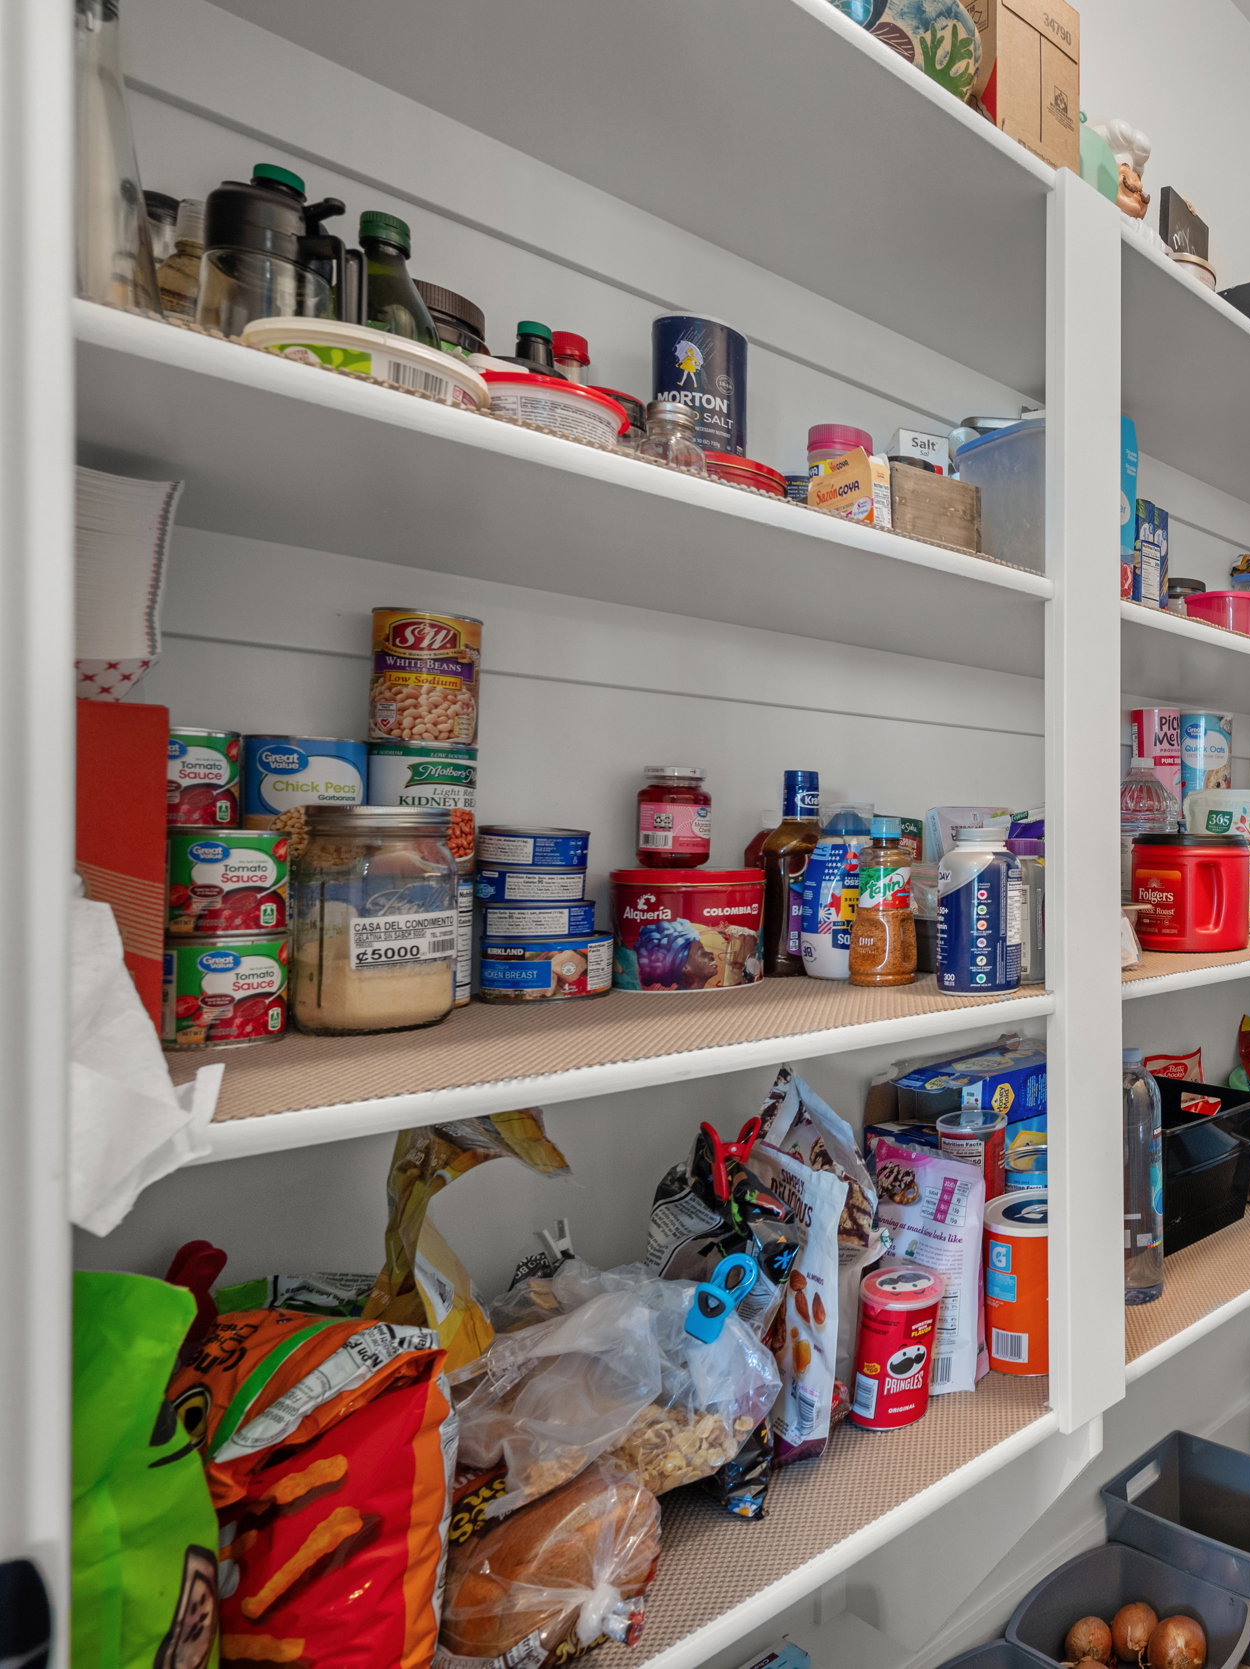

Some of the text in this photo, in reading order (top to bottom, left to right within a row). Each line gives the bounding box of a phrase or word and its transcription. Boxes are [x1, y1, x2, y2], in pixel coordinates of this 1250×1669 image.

[1043, 12, 1072, 46] 34790
[658, 391, 728, 414] MORTON
[704, 412, 733, 430] SALT
[912, 437, 936, 451] Salt
[816, 484, 838, 506] Sazón
[838, 480, 860, 498] GOYA
[386, 656, 462, 672] WHITE BEANS
[388, 674, 458, 688] Low Sodium
[1210, 745, 1225, 753] Oats
[262, 752, 299, 763] Great
[180, 760, 222, 771] Tomato
[270, 761, 299, 770] Value
[178, 770, 222, 781] Sauce
[414, 764, 466, 780] Mother's
[272, 780, 356, 794] Chick Peas
[432, 788, 460, 798] Light
[399, 796, 461, 808] KIDNEY
[804, 796, 819, 806] Kra
[1209, 814, 1229, 826] 365
[192, 846, 223, 854] Great
[224, 864, 268, 873] Tomato
[221, 873, 268, 884] Sauce
[1138, 888, 1174, 904] Folgers
[624, 906, 672, 922] Alquería
[703, 904, 752, 916] COLOMBIA
[1156, 907, 1175, 916] Roast
[354, 916, 454, 932] CASA DEL CONDIMENTO
[354, 932, 382, 942] GELATINA
[384, 932, 392, 940] SIN
[488, 948, 524, 956] KIRKLAND
[203, 956, 234, 964] Great
[235, 970, 274, 980] Tomato
[505, 970, 538, 979] BREAST
[232, 980, 274, 992] Sauce
[1168, 1064, 1185, 1073] Betty
[880, 1216, 899, 1230] inning
[932, 1230, 947, 1242] looks
[948, 1234, 963, 1244] like
[993, 1246, 1007, 1267] G
[807, 1270, 824, 1286] ALMONDS
[912, 1318, 933, 1330] BURSTING
[911, 1325, 932, 1337] FLAVOR
[883, 1371, 924, 1396] PRINGLES
[888, 1403, 916, 1414] ORIGINAL
